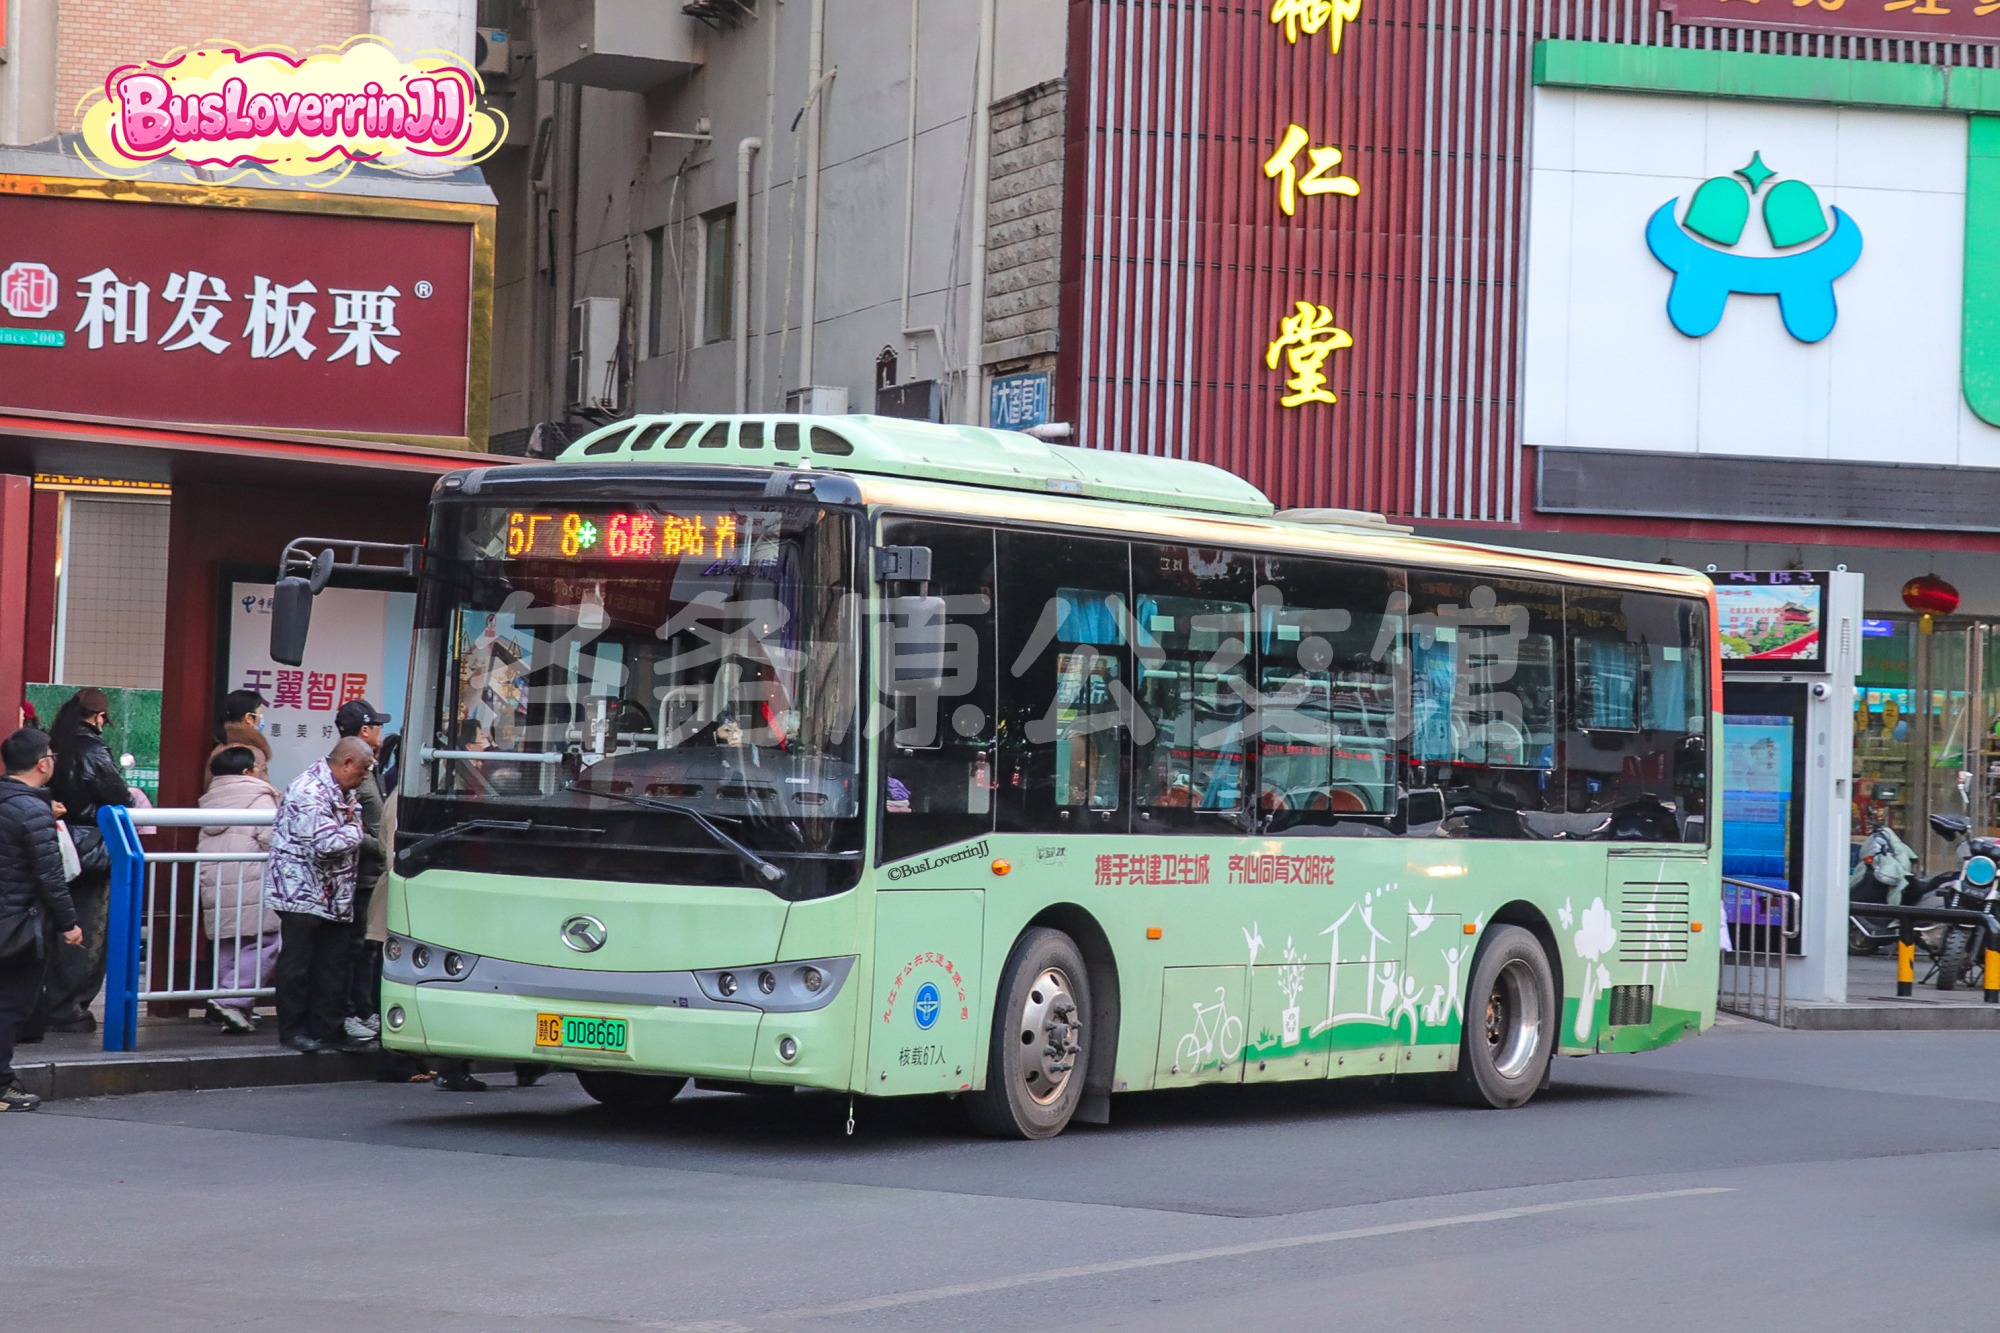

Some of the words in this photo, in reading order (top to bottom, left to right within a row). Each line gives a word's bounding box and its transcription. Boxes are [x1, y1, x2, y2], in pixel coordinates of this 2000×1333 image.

[75, 267, 402, 366] 和发板栗
[32, 331, 65, 346] 2002
[608, 514, 655, 557] 6路
[243, 669, 368, 712] 天翼智屏
[1095, 853, 1210, 886] 携手共建卫生城
[1228, 854, 1335, 886] 齐心同育文明花
[898, 1045, 946, 1067] 核载67人
